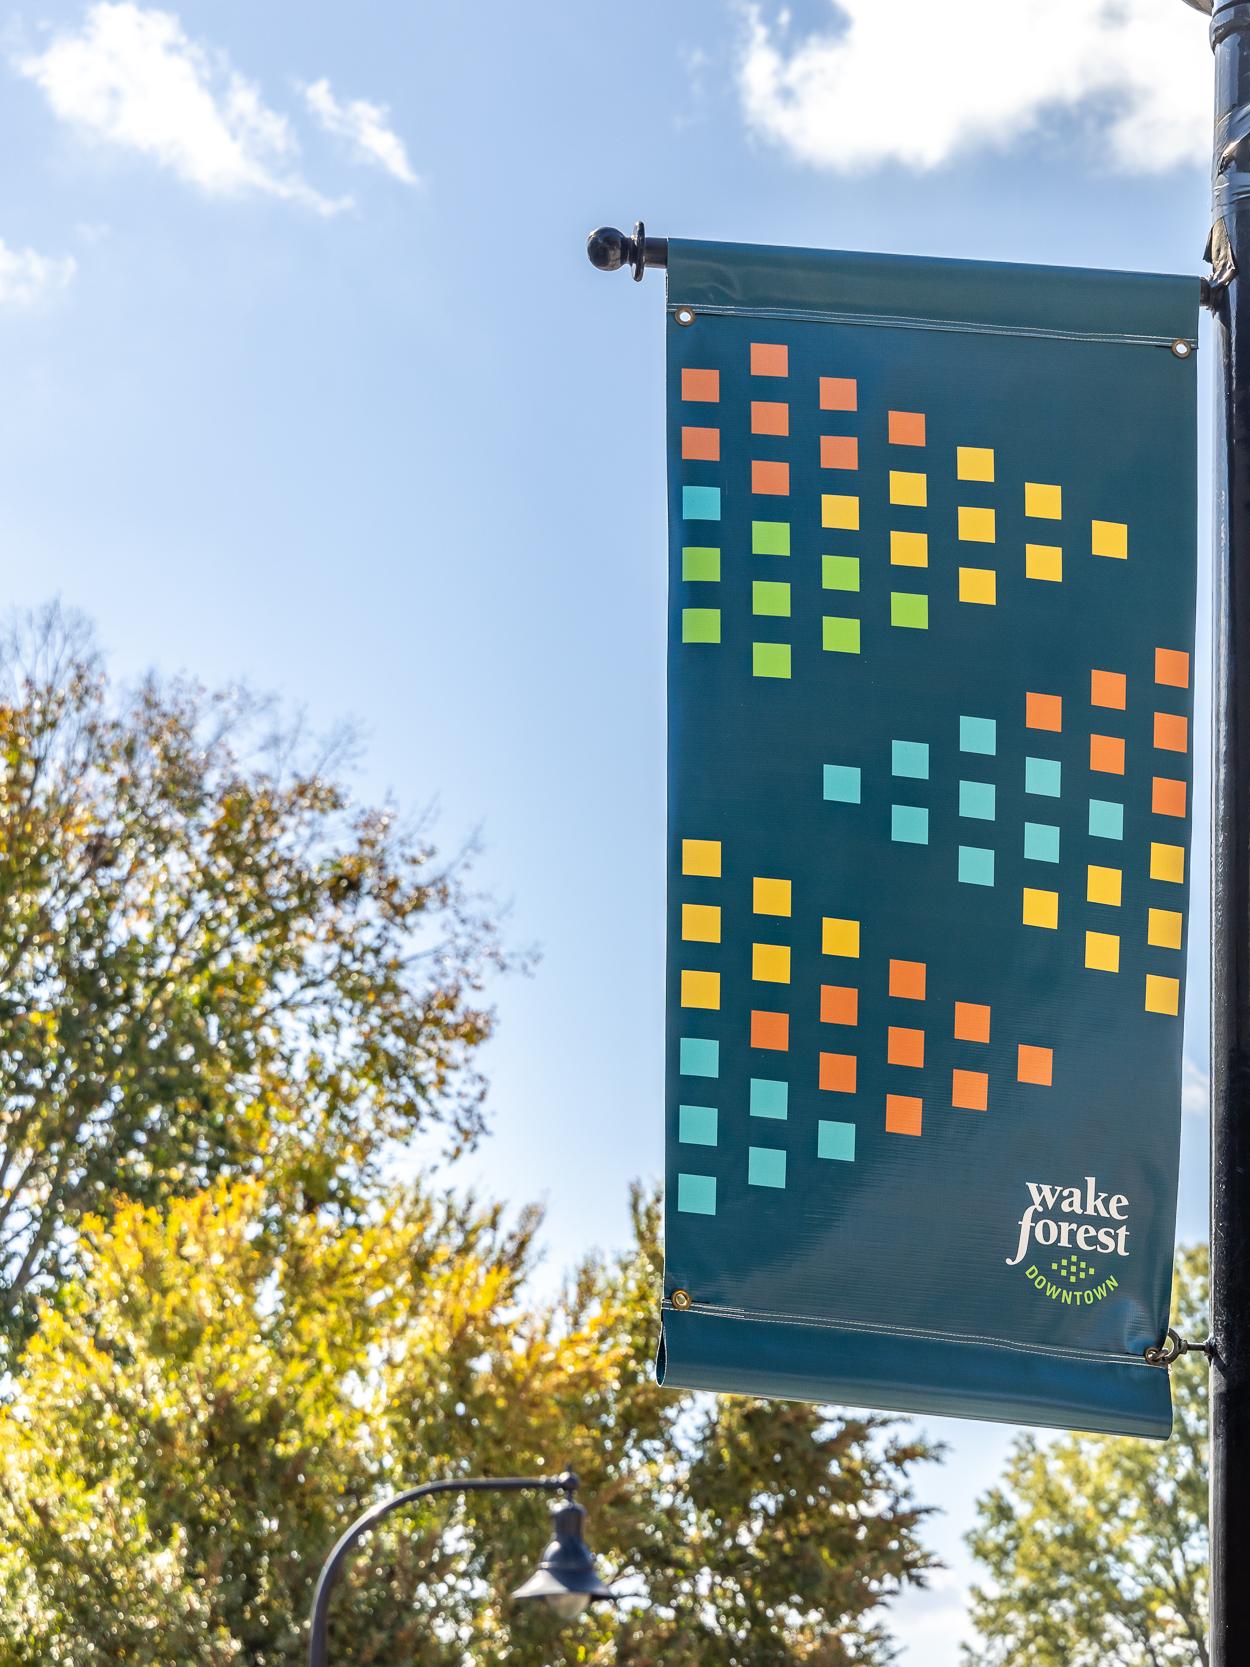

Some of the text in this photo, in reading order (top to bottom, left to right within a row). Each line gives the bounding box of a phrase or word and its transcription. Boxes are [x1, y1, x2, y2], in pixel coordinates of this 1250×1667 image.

[1025, 1176, 1130, 1221] wake
[1005, 1204, 1130, 1266] forest
[1025, 1264, 1119, 1306] DOWNTOWN
